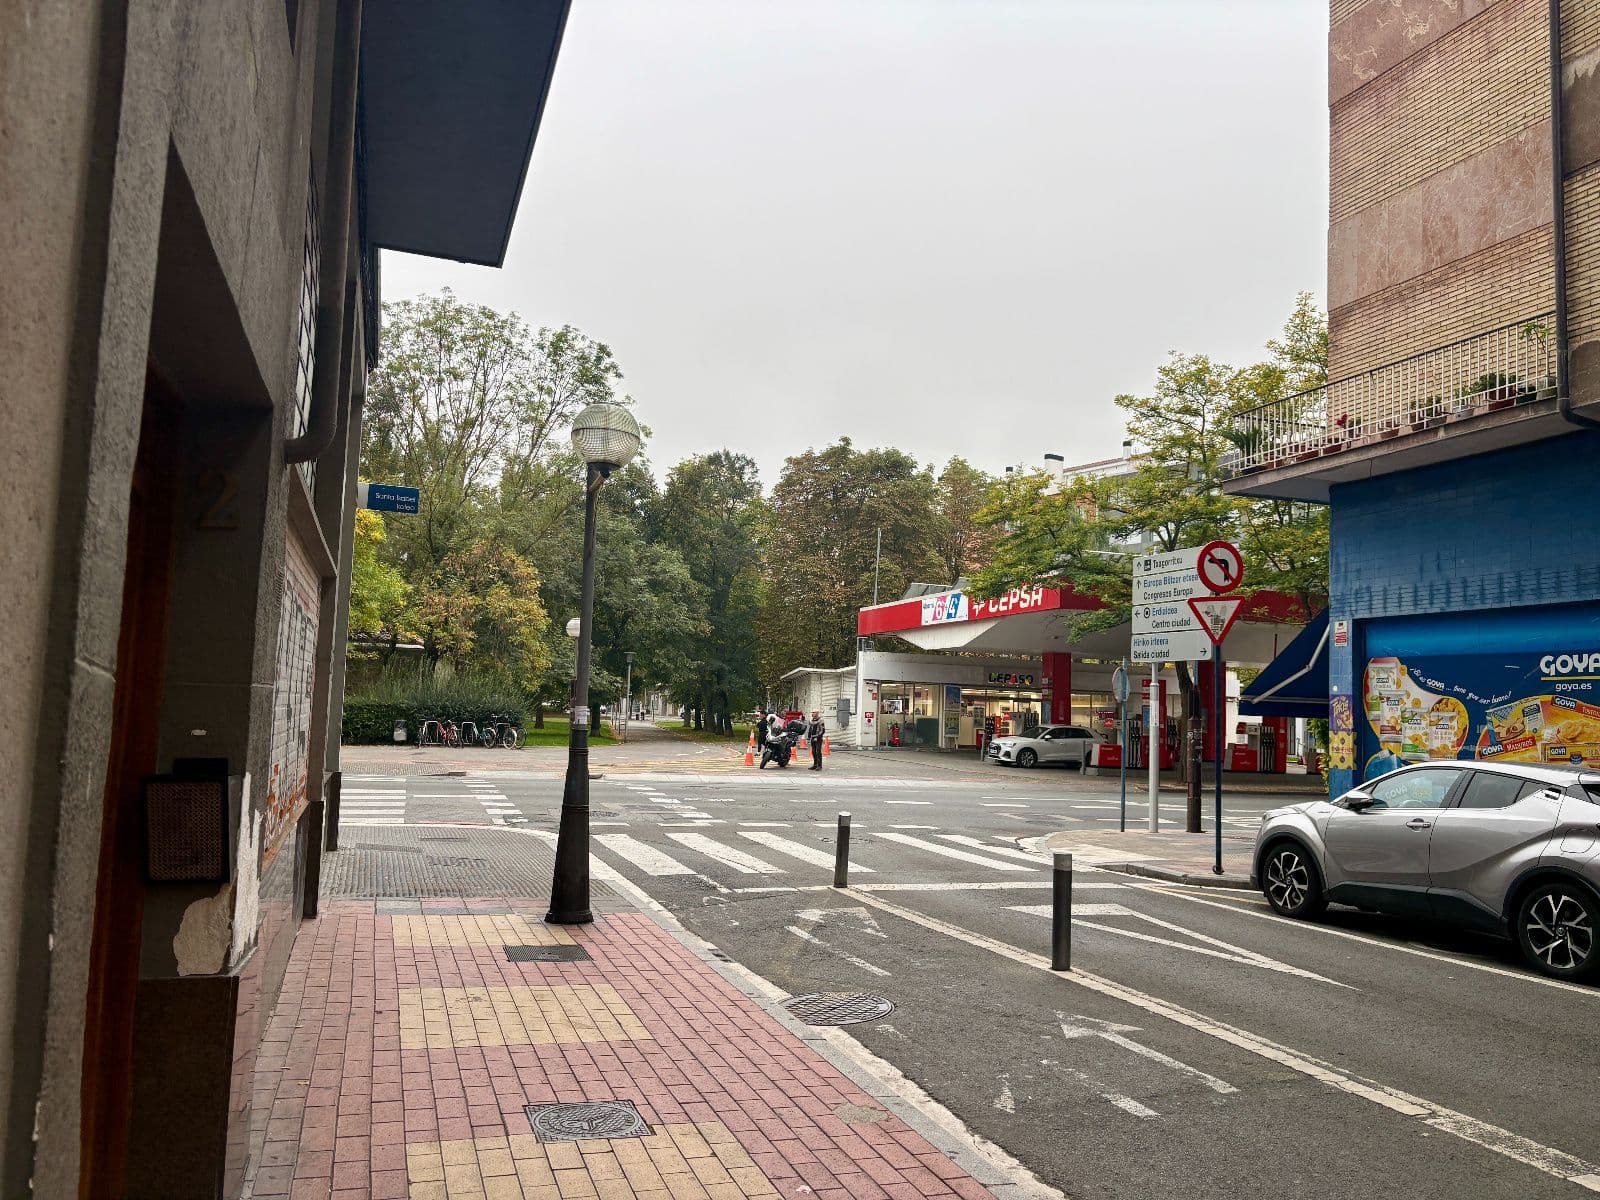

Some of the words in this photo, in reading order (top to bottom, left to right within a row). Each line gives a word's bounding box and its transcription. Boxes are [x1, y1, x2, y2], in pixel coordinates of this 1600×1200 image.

[1152, 619, 1171, 629] Centro
[1171, 617, 1191, 627] ciudad
[1540, 653, 1600, 676] GOYA
[1426, 678, 1445, 690] GOYA
[1555, 683, 1593, 692] goya.es
[1555, 697, 1576, 708] GOYA
[1482, 744, 1503, 756] GOYA
